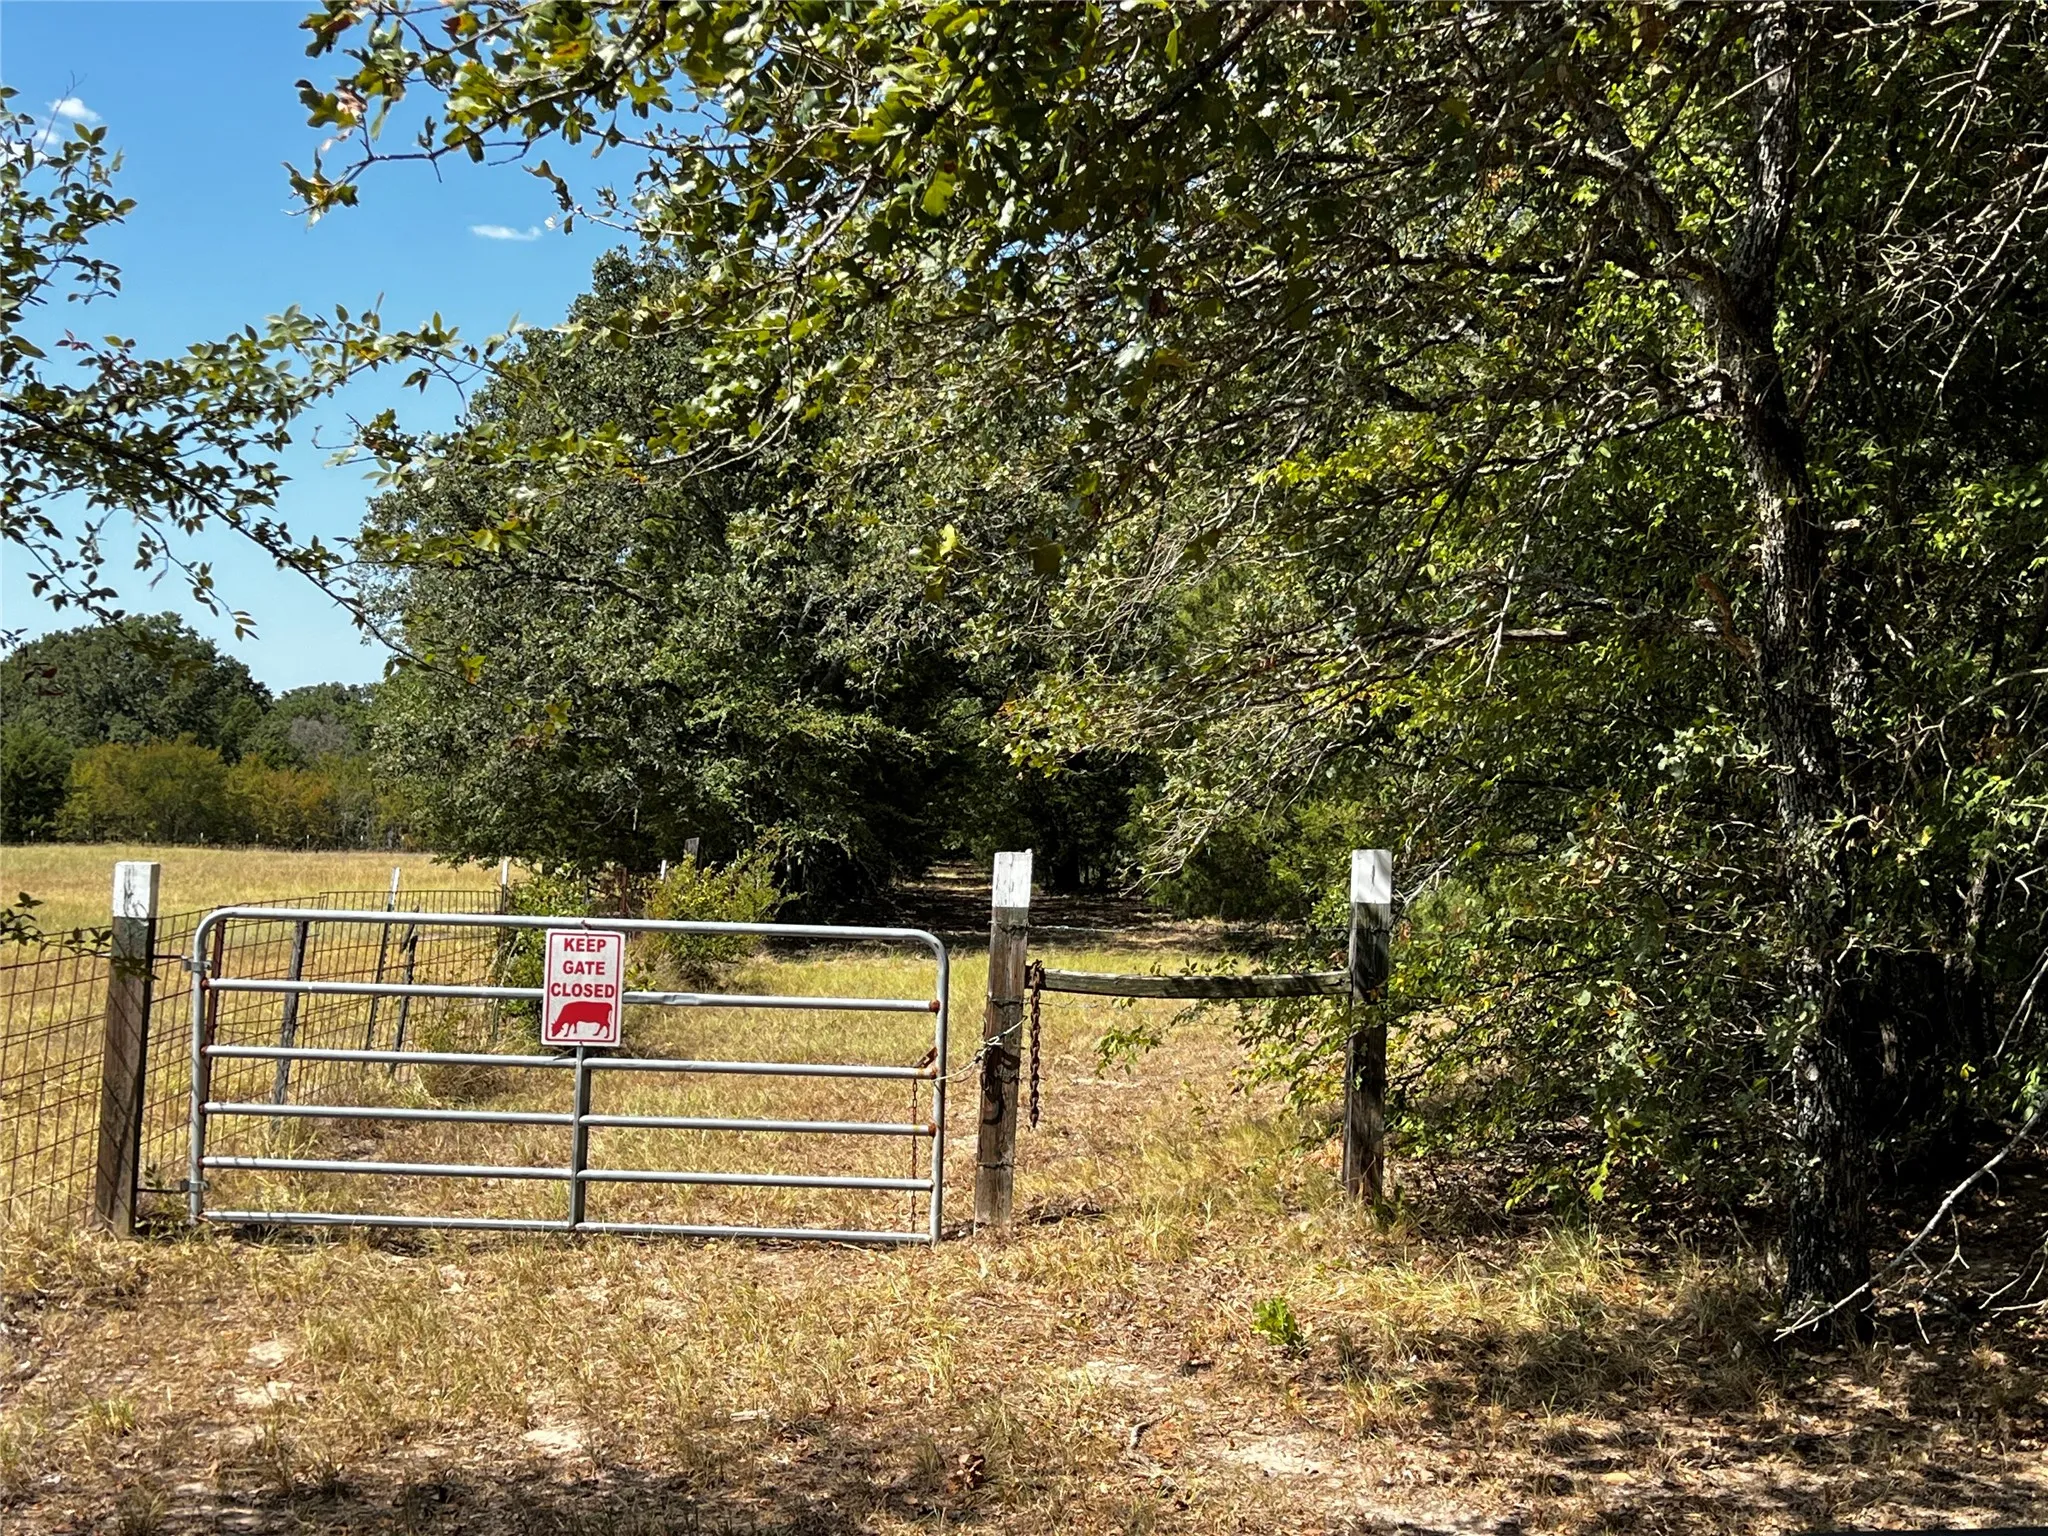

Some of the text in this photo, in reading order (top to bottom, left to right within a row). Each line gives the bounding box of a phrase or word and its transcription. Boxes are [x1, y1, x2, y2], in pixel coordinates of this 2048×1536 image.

[564, 938, 607, 952] KEEP
[563, 960, 606, 975] GATE
[551, 983, 615, 998] CLOSED
